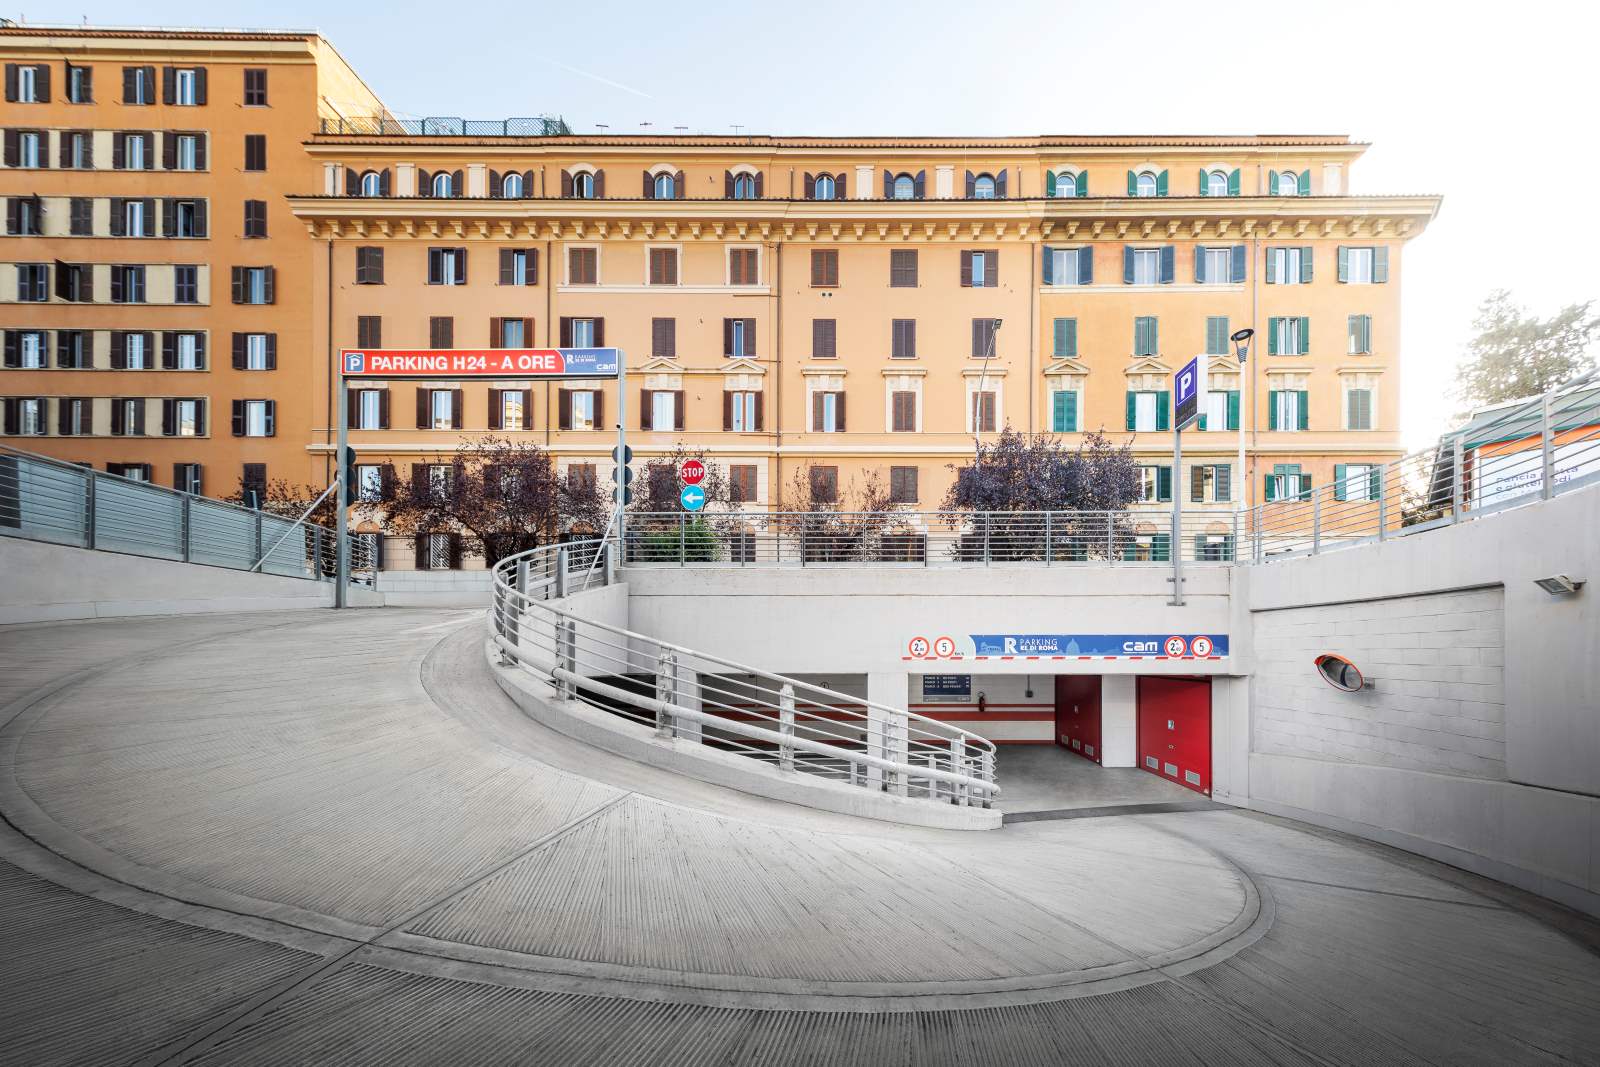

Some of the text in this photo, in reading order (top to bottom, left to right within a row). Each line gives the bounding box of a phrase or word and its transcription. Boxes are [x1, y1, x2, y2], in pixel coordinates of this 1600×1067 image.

[350, 358, 360, 370] P
[371, 356, 448, 370] PARKING
[453, 356, 487, 370] H24
[501, 355, 514, 369] A
[518, 355, 556, 369] ORE
[1180, 371, 1192, 401] P
[682, 467, 704, 478] STOP
[942, 643, 947, 652] 5
[1004, 637, 1018, 654] R
[1020, 638, 1058, 646] PARKING
[1122, 641, 1158, 652] cam
[1200, 642, 1204, 652] 5
